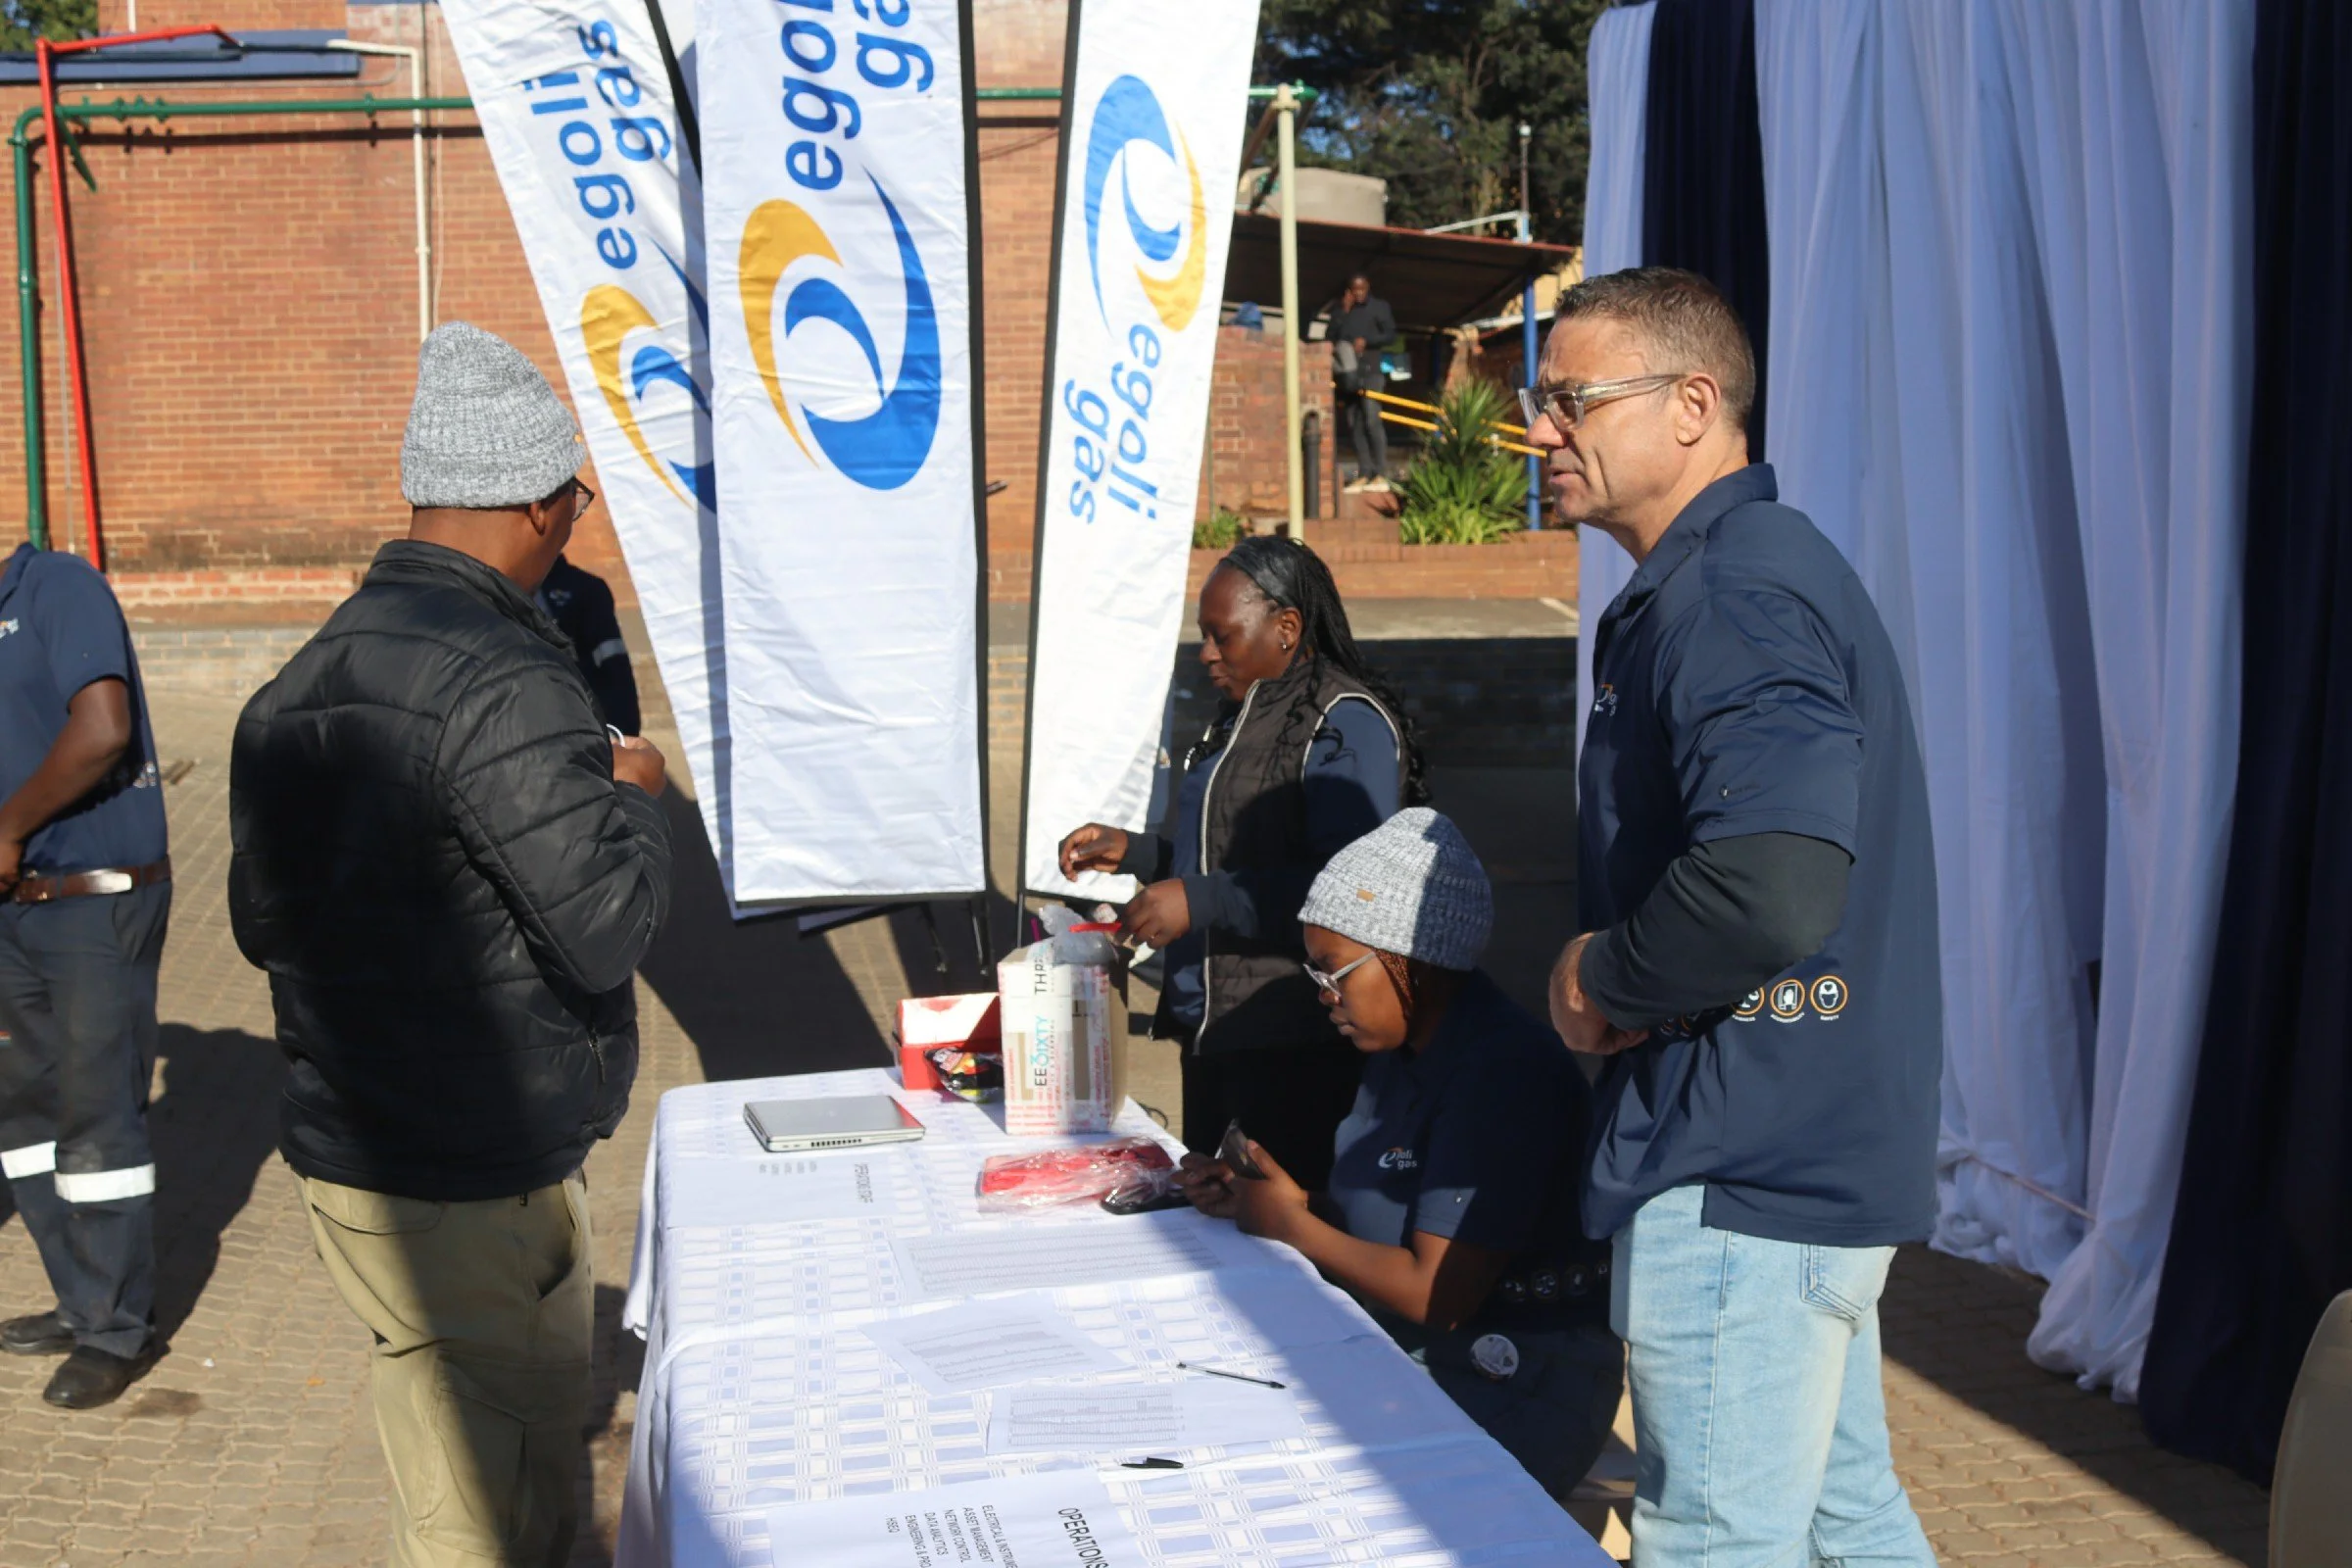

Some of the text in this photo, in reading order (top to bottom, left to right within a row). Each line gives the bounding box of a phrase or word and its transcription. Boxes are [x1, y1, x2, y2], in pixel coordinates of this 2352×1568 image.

[577, 19, 671, 161] gas
[523, 72, 635, 270] egoli
[1110, 323, 1162, 520] egoli
[1064, 378, 1110, 524] gas
[905, 1514, 926, 1551] ENGINEERING
[924, 1511, 949, 1556] DATA ANALYTICS
[944, 1509, 972, 1563] NETWORK CONTROL
[962, 1506, 994, 1563] ASSET MANAGEMENT
[981, 1504, 1003, 1540] ELECTRICAL
